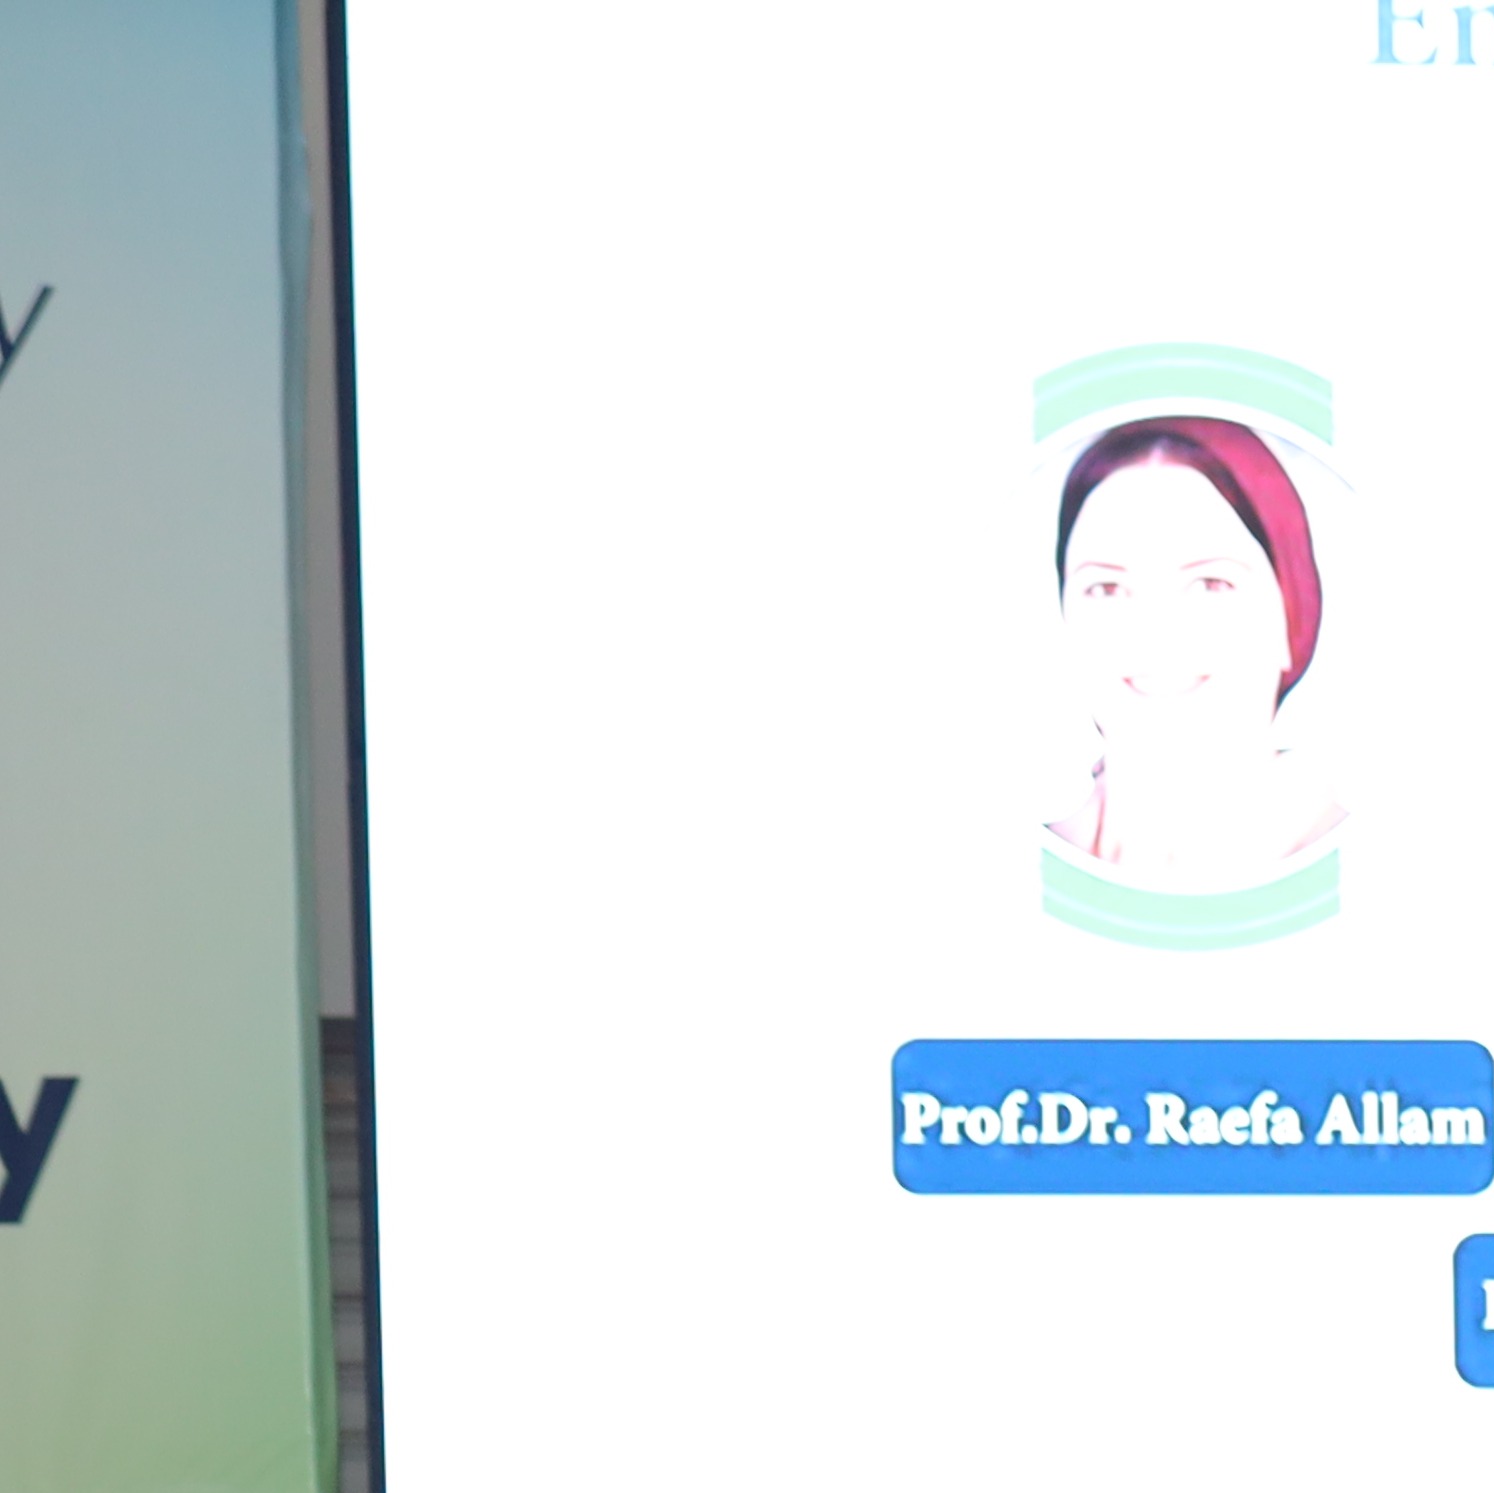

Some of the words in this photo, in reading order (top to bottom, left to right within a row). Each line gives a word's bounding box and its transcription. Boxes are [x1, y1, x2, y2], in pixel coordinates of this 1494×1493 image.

[902, 1090, 1132, 1145] Prof.Dr.
[1146, 1091, 1303, 1145] Raefa
[1317, 1092, 1485, 1145] Allam
